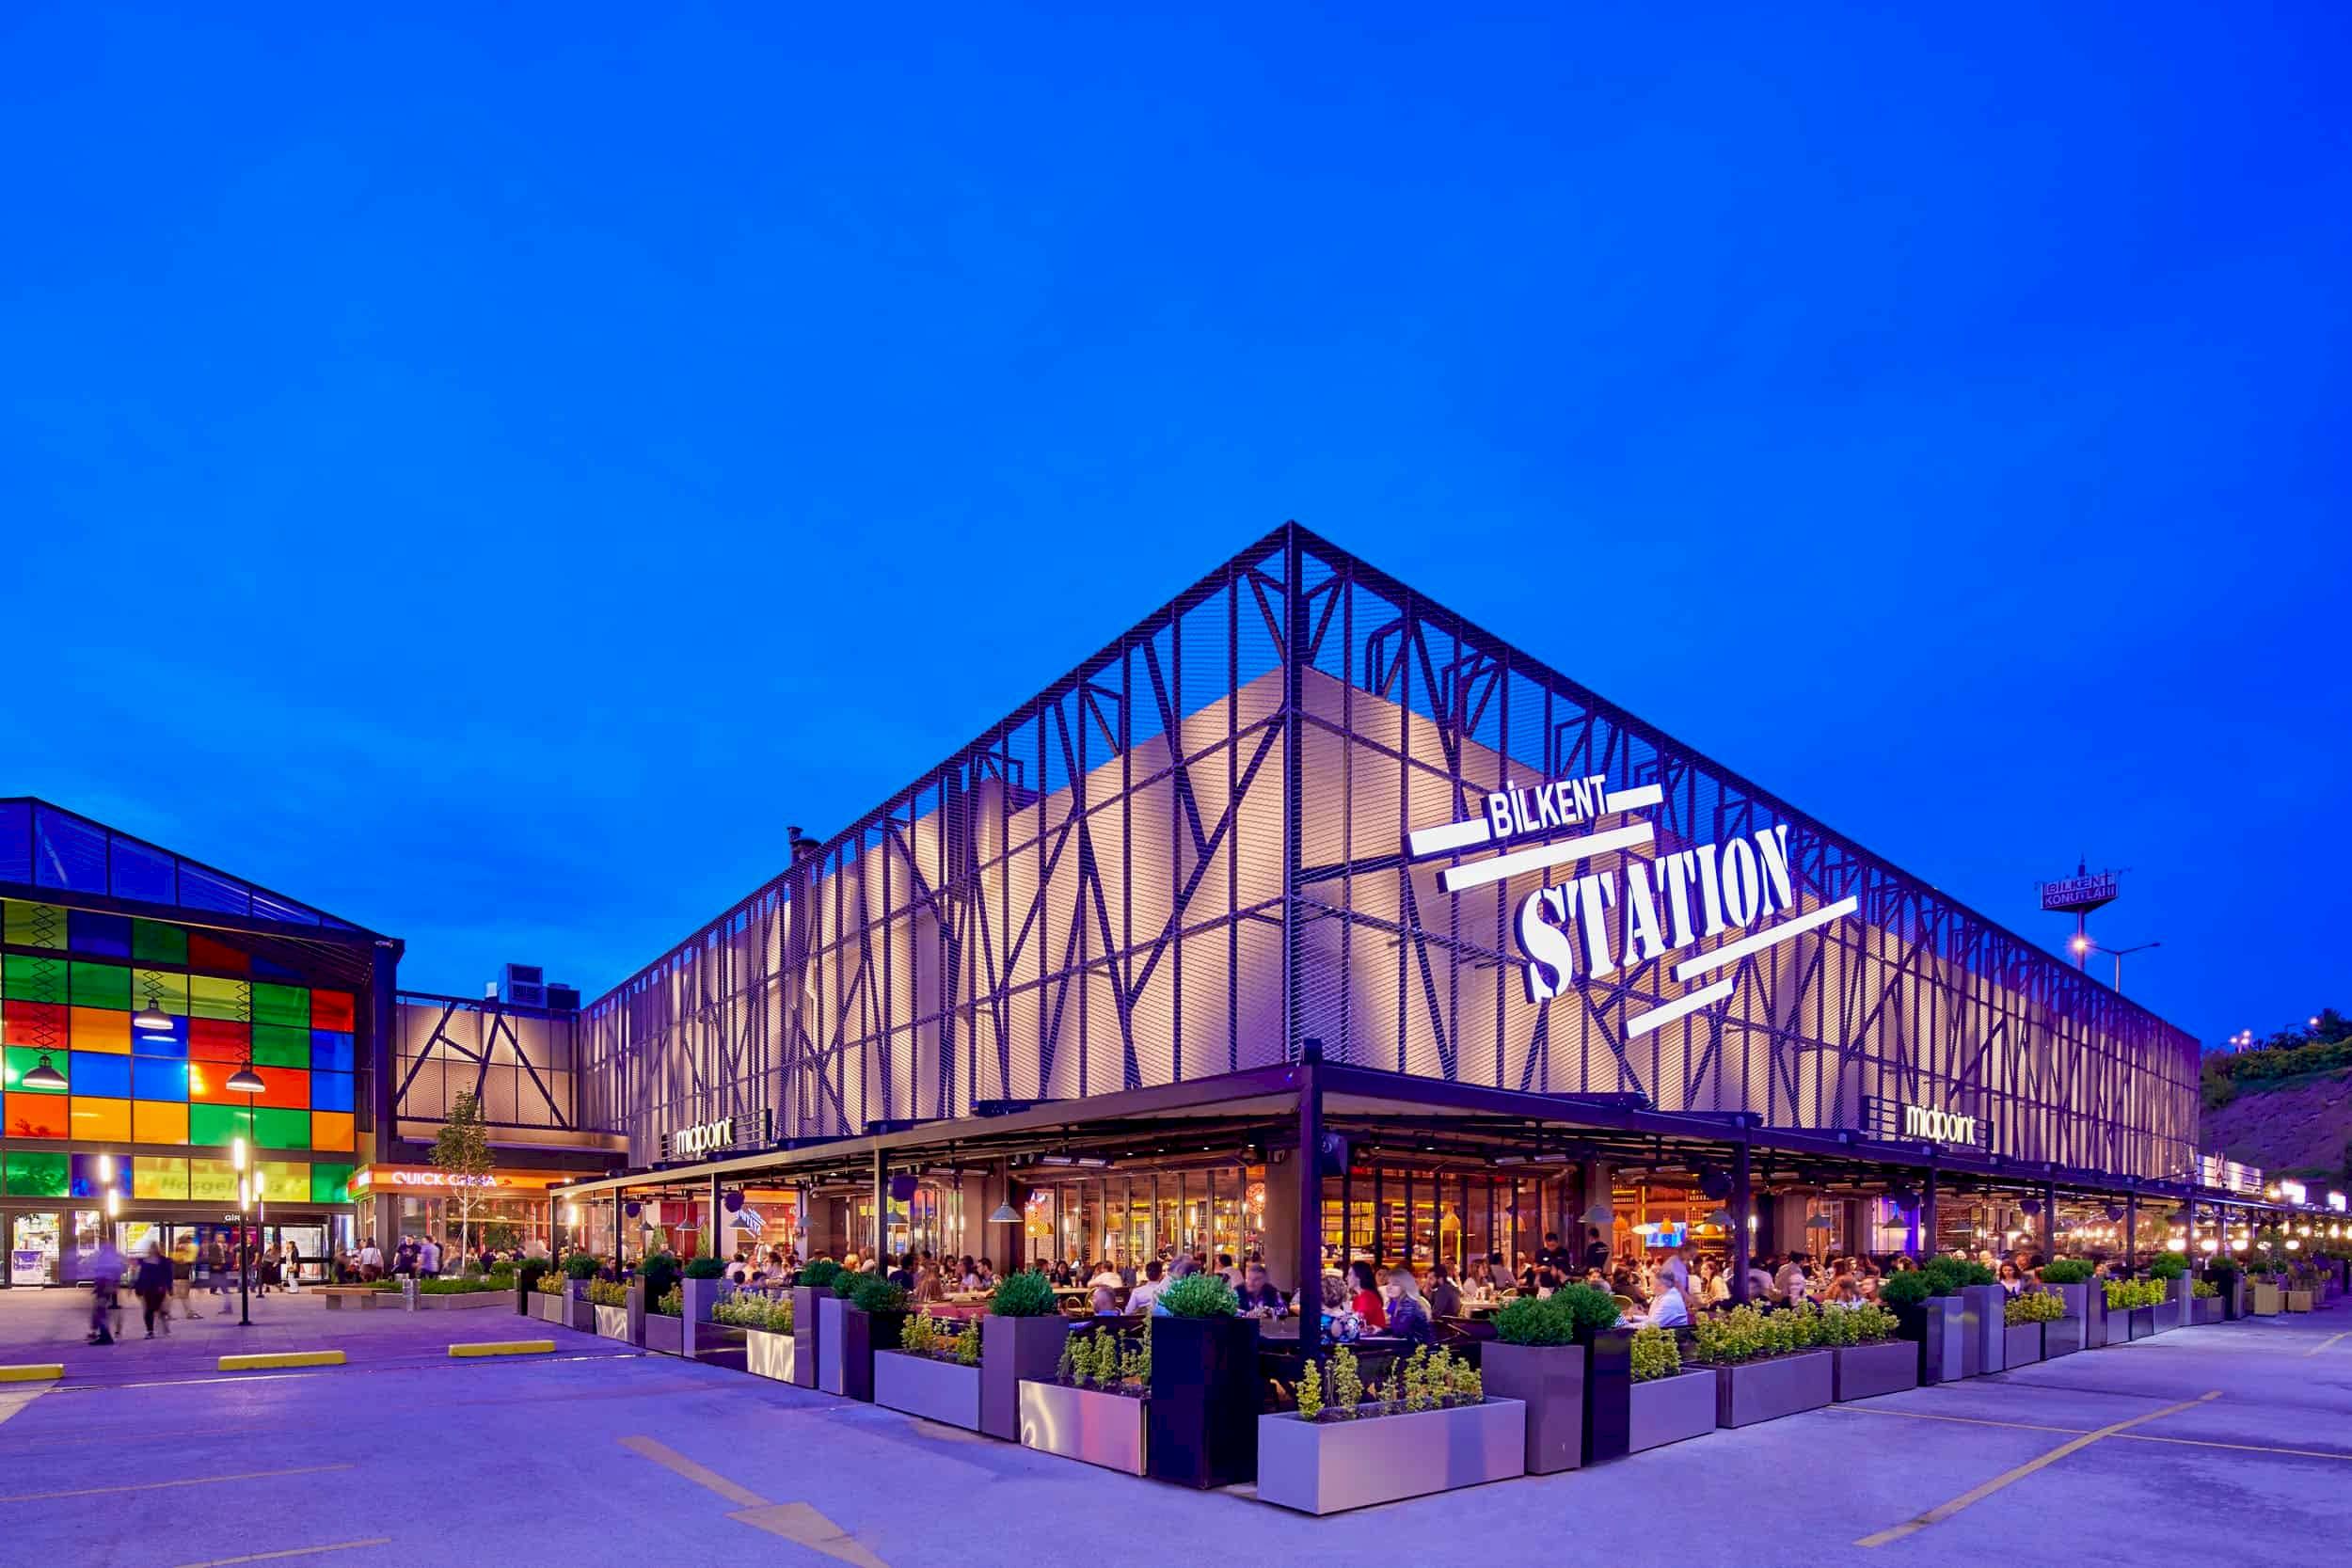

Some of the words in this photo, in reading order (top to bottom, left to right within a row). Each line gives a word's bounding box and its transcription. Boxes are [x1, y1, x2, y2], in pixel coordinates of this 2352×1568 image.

[1489, 774, 1607, 838] BİLKENT
[1518, 824, 1793, 1003] STATION
[676, 1117, 733, 1161] midpoint
[1906, 1103, 1976, 1145] midpoint
[391, 1171, 444, 1186] QUICK
